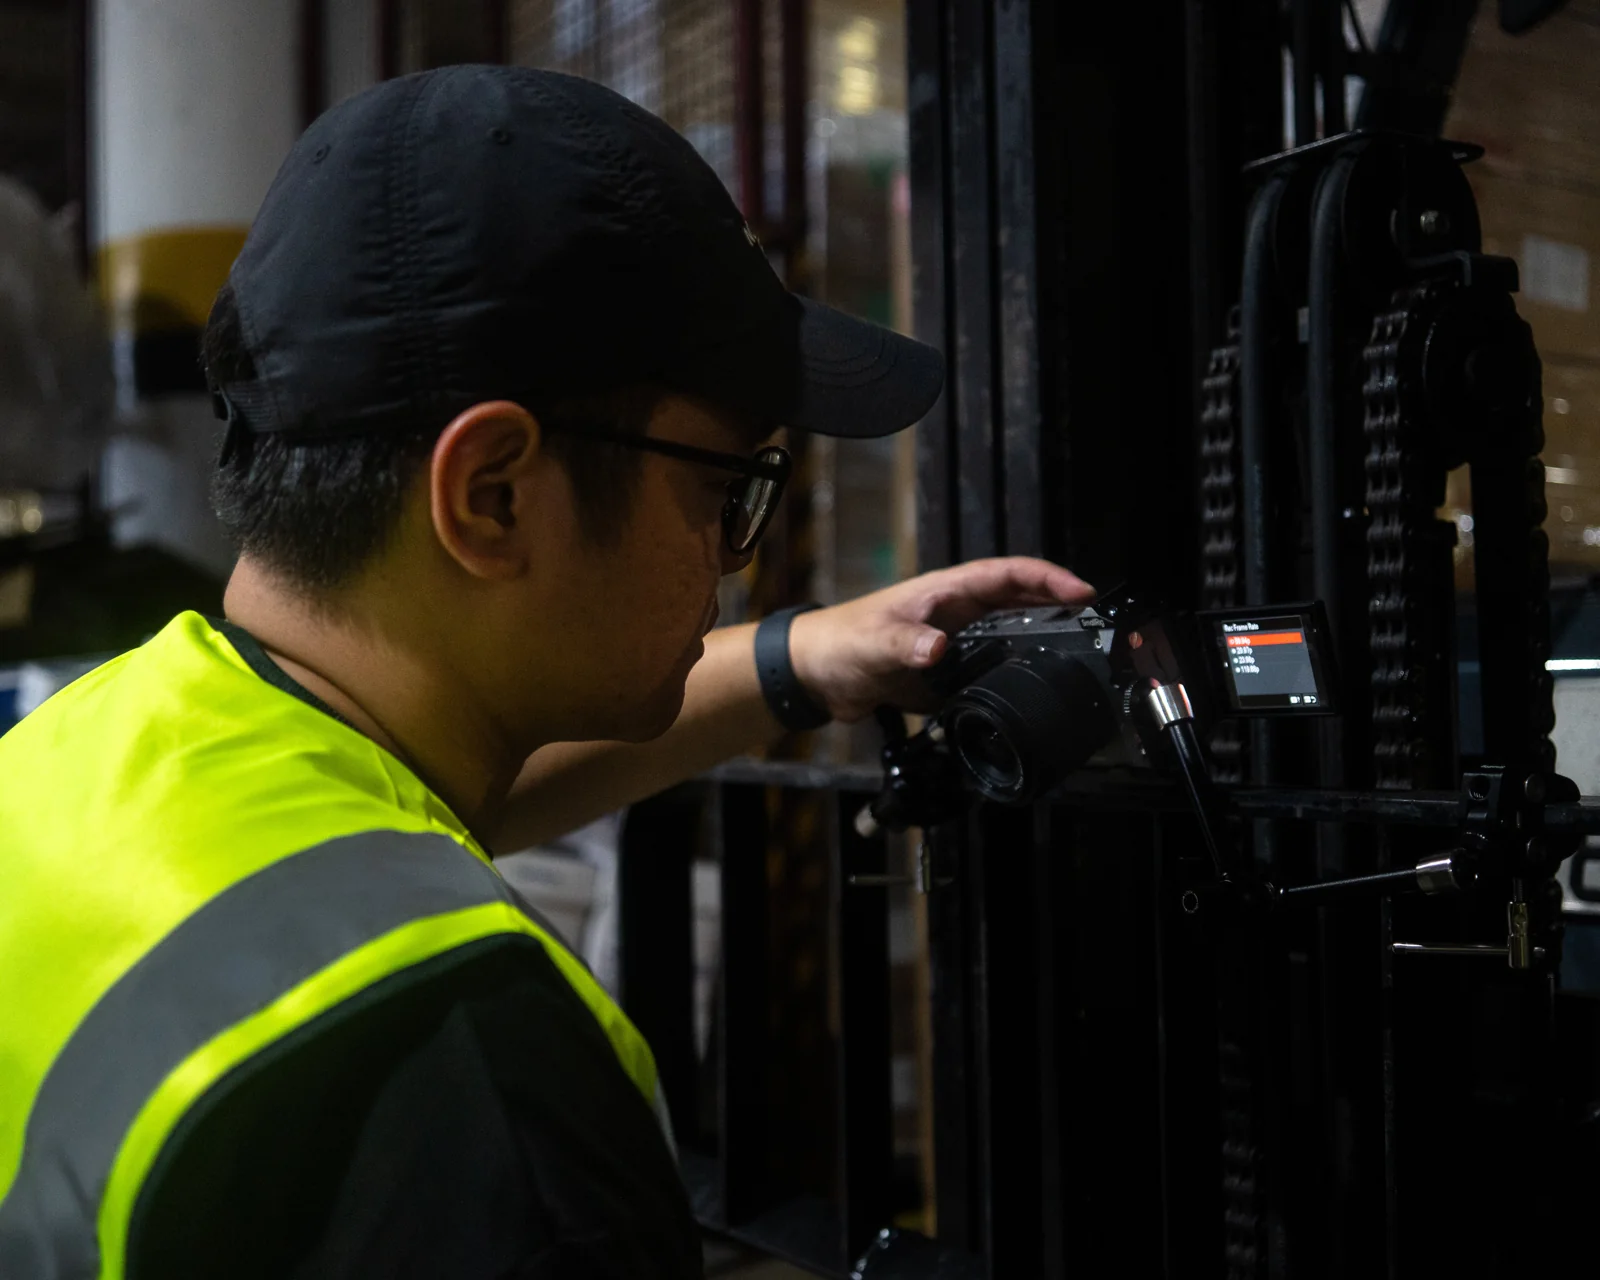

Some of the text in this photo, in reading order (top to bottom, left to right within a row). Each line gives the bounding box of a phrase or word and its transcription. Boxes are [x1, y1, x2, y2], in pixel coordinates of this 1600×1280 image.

[1223, 622, 1259, 632] Rec Frame Rate
